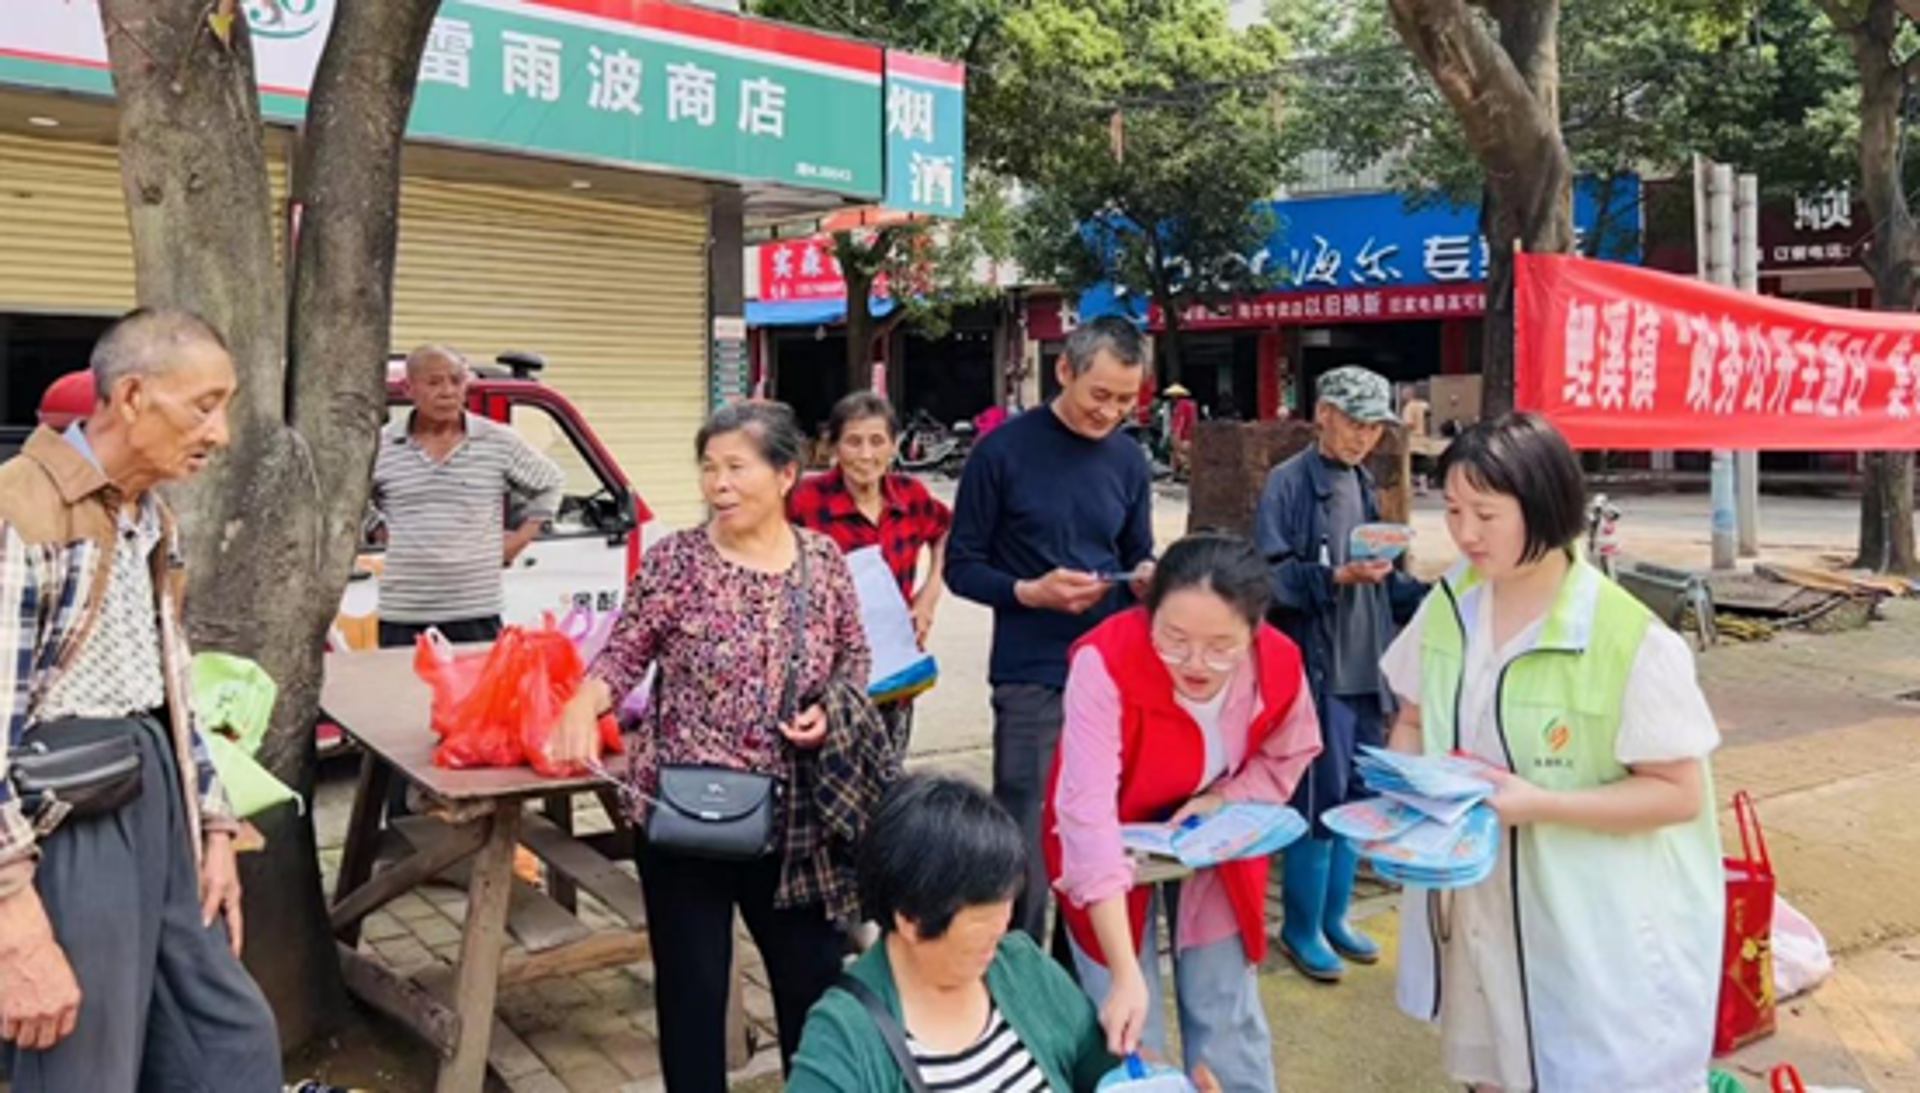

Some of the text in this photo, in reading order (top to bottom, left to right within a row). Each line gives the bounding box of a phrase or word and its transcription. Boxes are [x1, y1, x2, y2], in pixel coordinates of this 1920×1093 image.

[417, 17, 786, 138] 雷雨波商店
